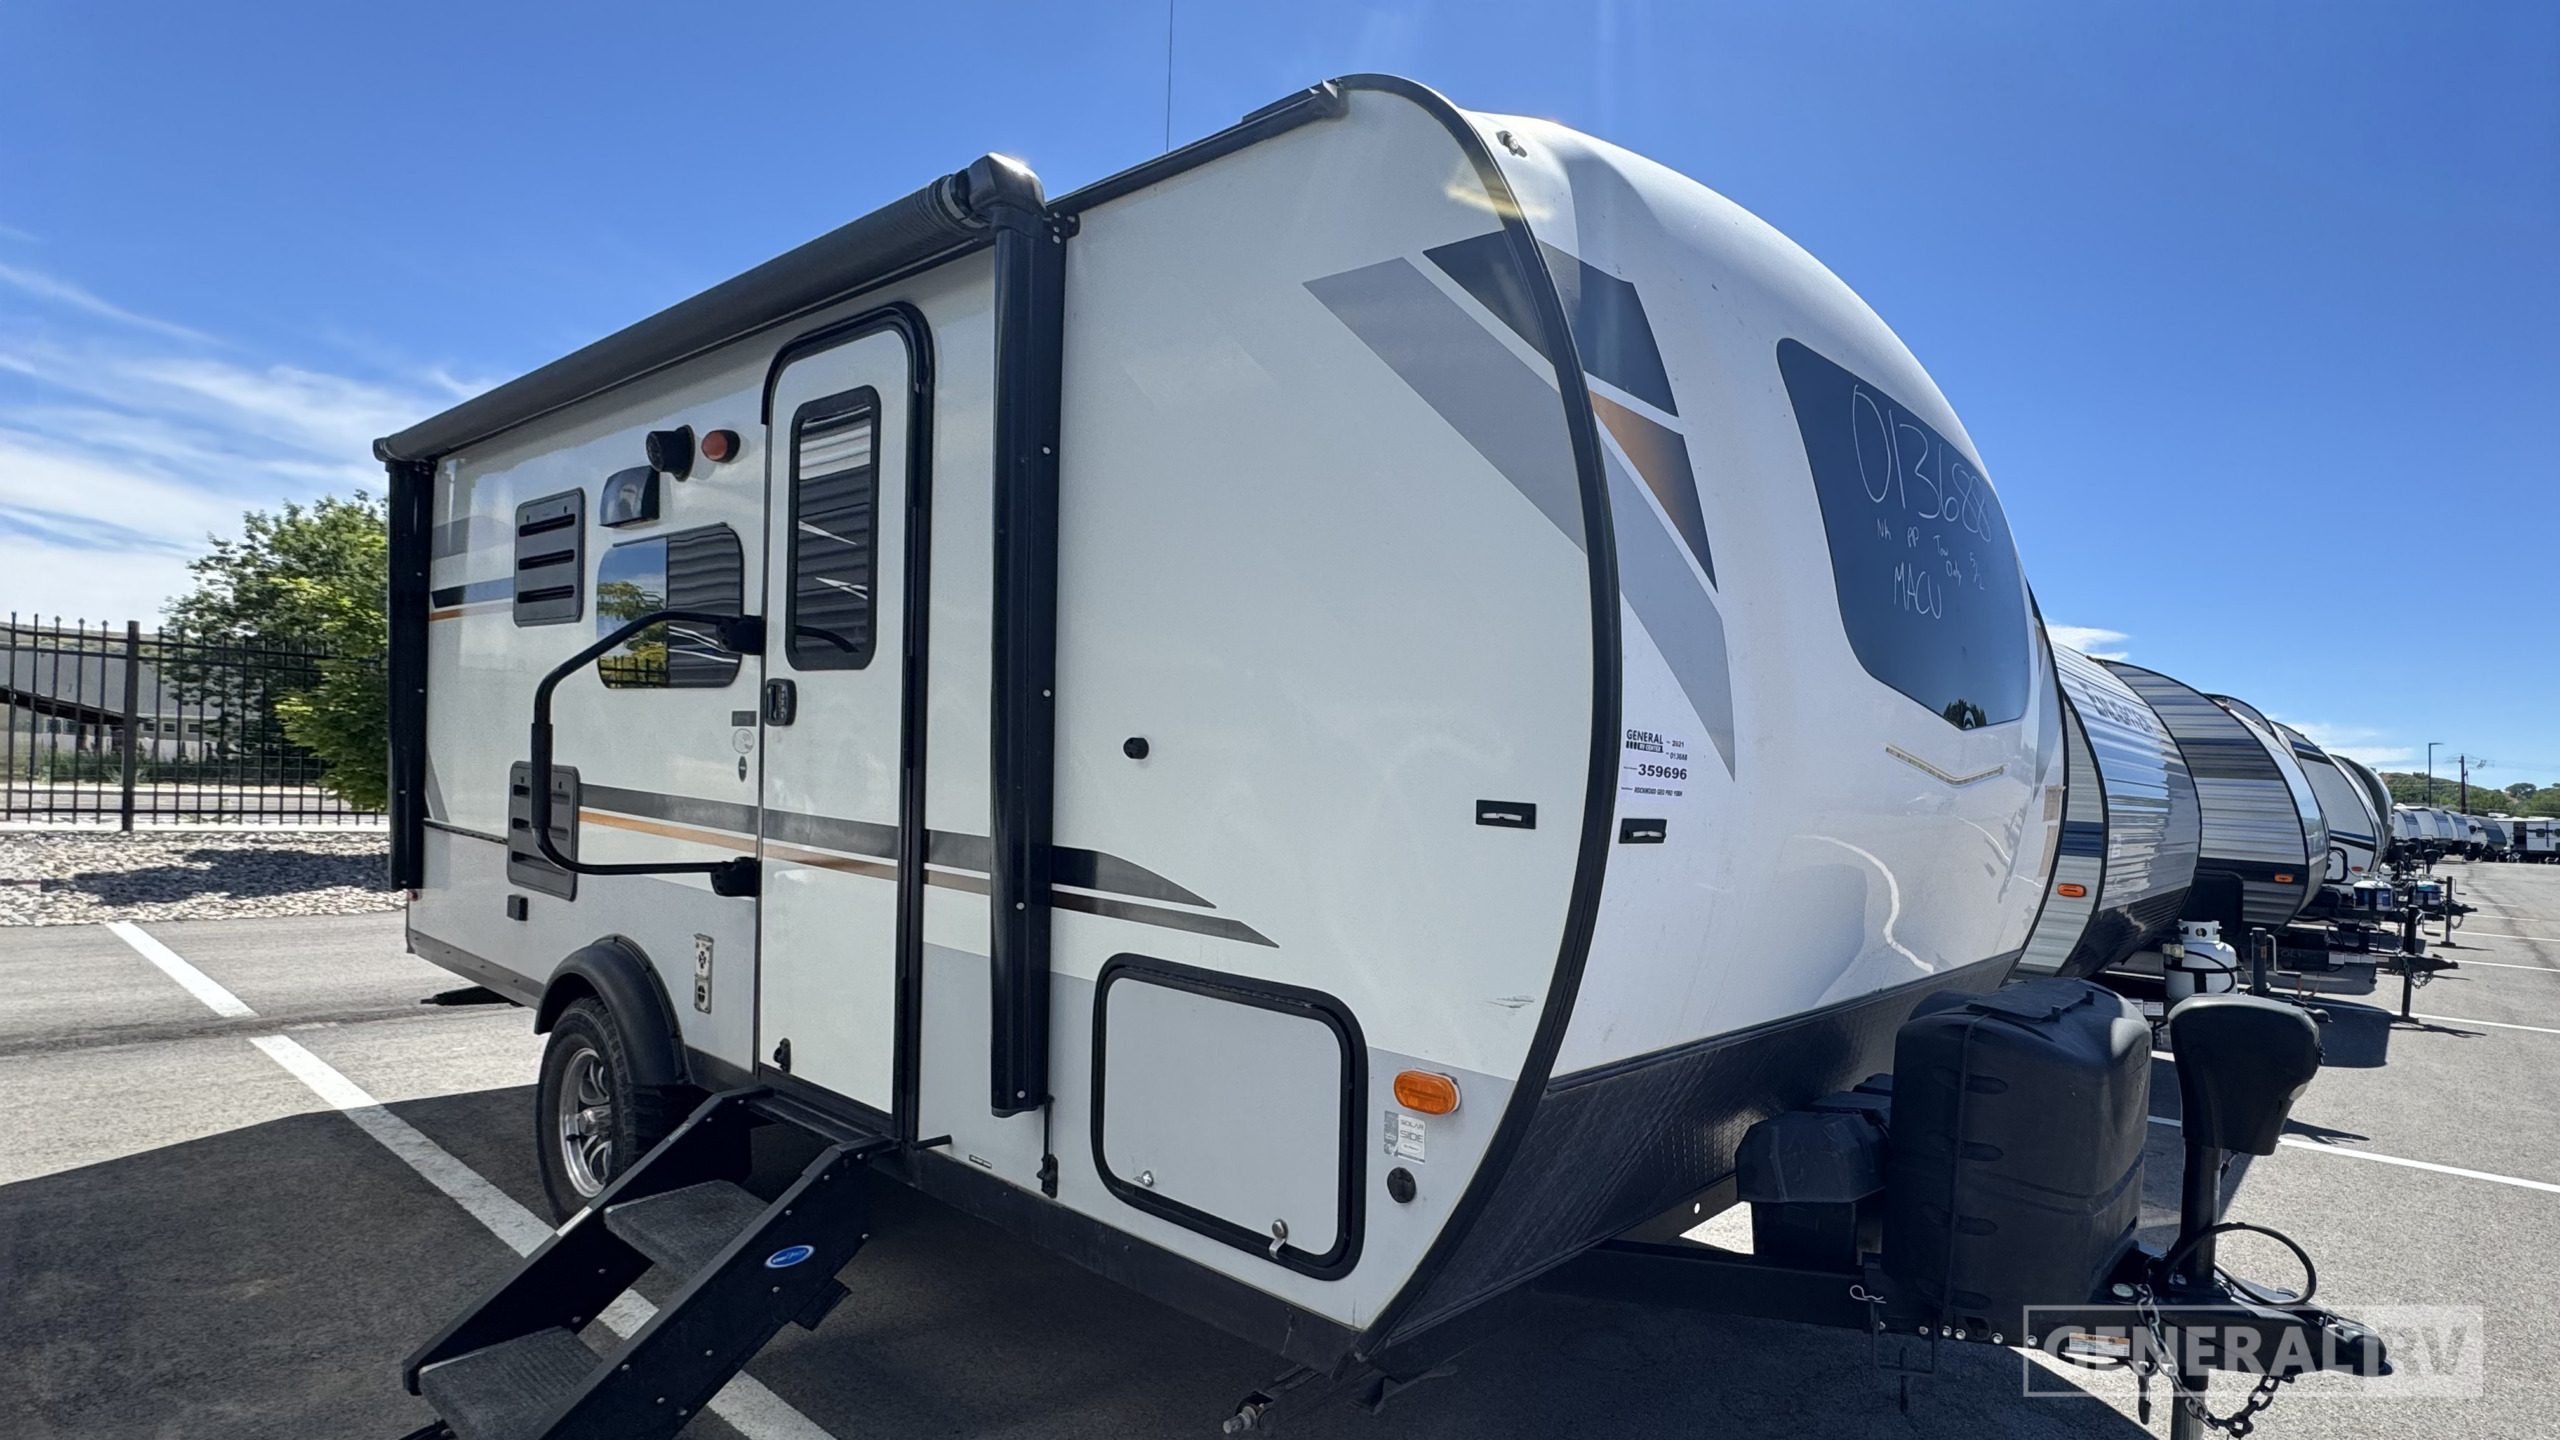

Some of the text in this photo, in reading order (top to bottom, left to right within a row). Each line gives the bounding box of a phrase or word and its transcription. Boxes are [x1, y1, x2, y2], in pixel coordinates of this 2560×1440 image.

[1853, 384, 1991, 542] 013688
[1894, 561, 1942, 619] MACU
[1626, 729, 1664, 744] GENERAL
[1638, 763, 1687, 780] 359696
[1400, 1119, 1424, 1130] SOLAR
[1400, 1130, 1423, 1143] SIDE
